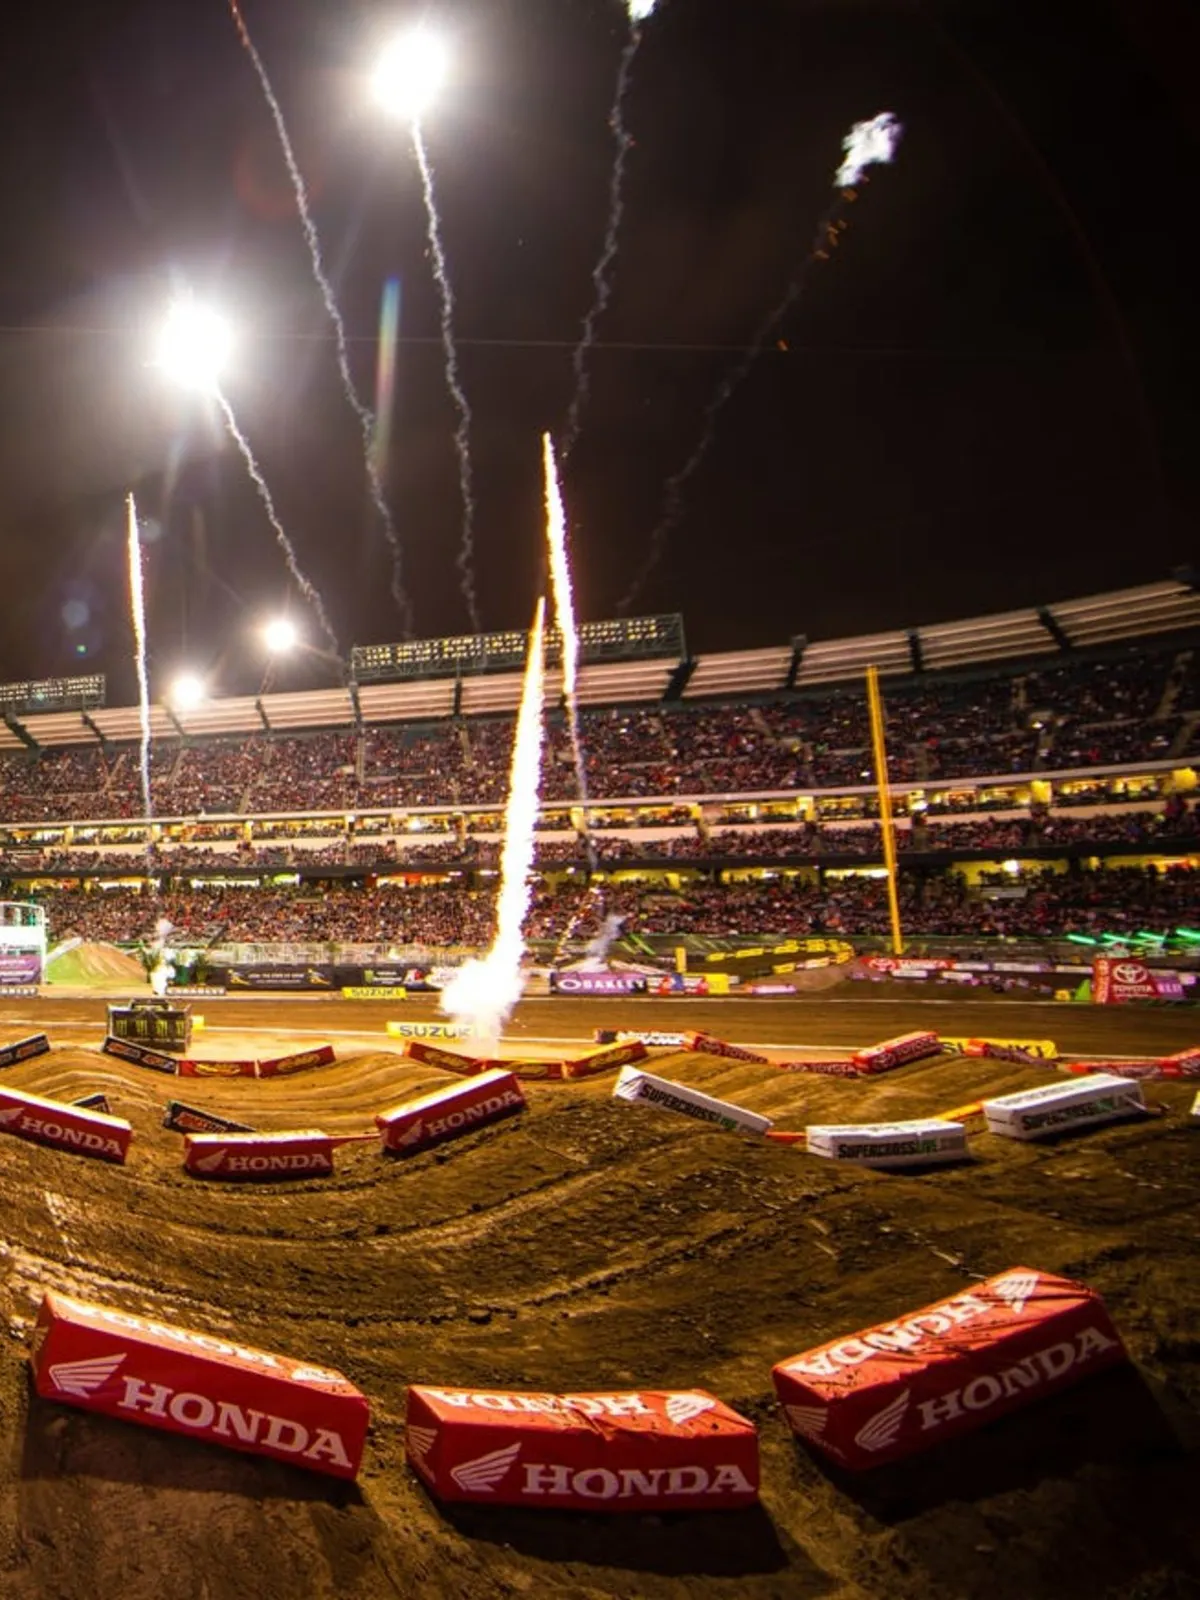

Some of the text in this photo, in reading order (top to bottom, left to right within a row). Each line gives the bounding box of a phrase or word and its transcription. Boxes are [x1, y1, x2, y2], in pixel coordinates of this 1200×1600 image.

[351, 988, 400, 997] SUZUKI
[399, 1024, 473, 1038] SUZUK
[426, 1090, 523, 1137] HONDA
[21, 1116, 123, 1156] HONDA
[229, 1153, 331, 1172] HONDA
[784, 1293, 994, 1376] HONDA
[917, 1327, 1118, 1431] HONDA
[118, 1375, 353, 1469] HONDA
[522, 1463, 756, 1499] HONDA
